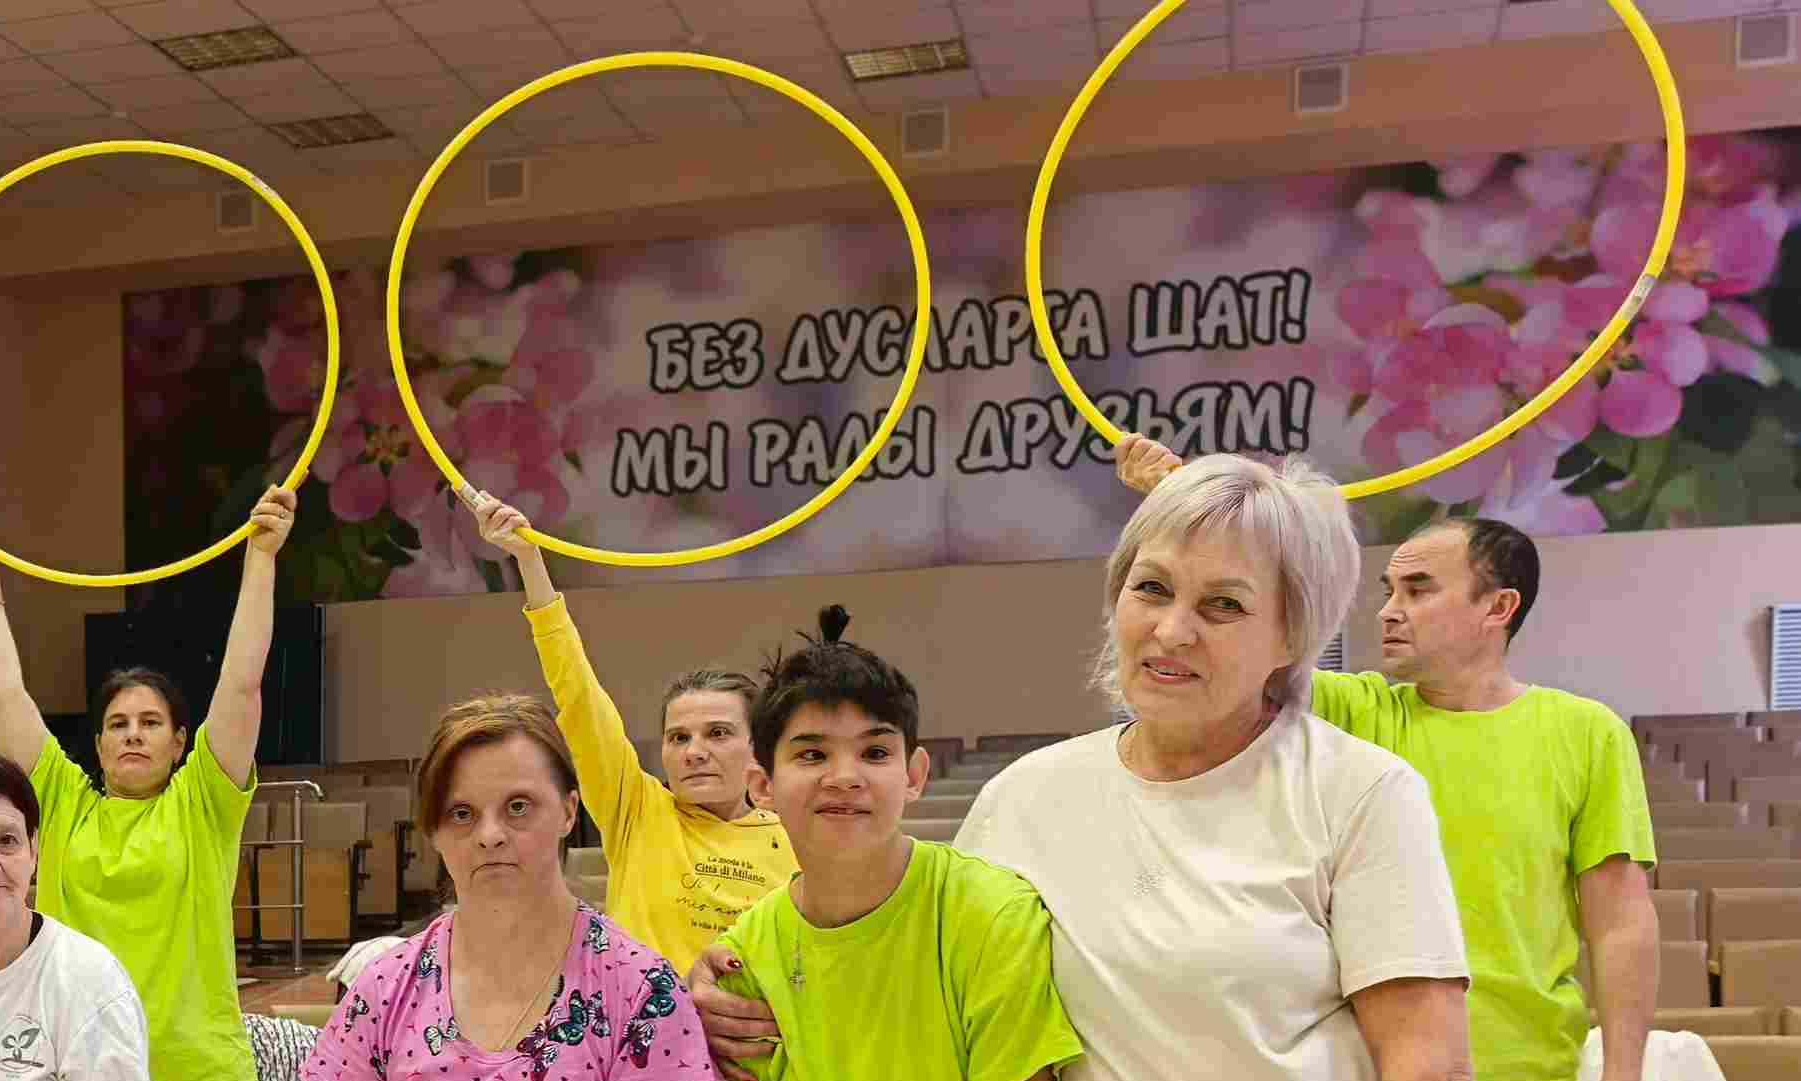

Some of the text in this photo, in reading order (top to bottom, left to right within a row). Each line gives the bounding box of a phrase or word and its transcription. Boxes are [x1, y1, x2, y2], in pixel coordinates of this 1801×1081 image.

[647, 319, 763, 393] БЕЗ
[1127, 267, 1312, 358] ШАТ!
[611, 421, 729, 497] МЫ
[749, 405, 936, 487] РАДЫ
